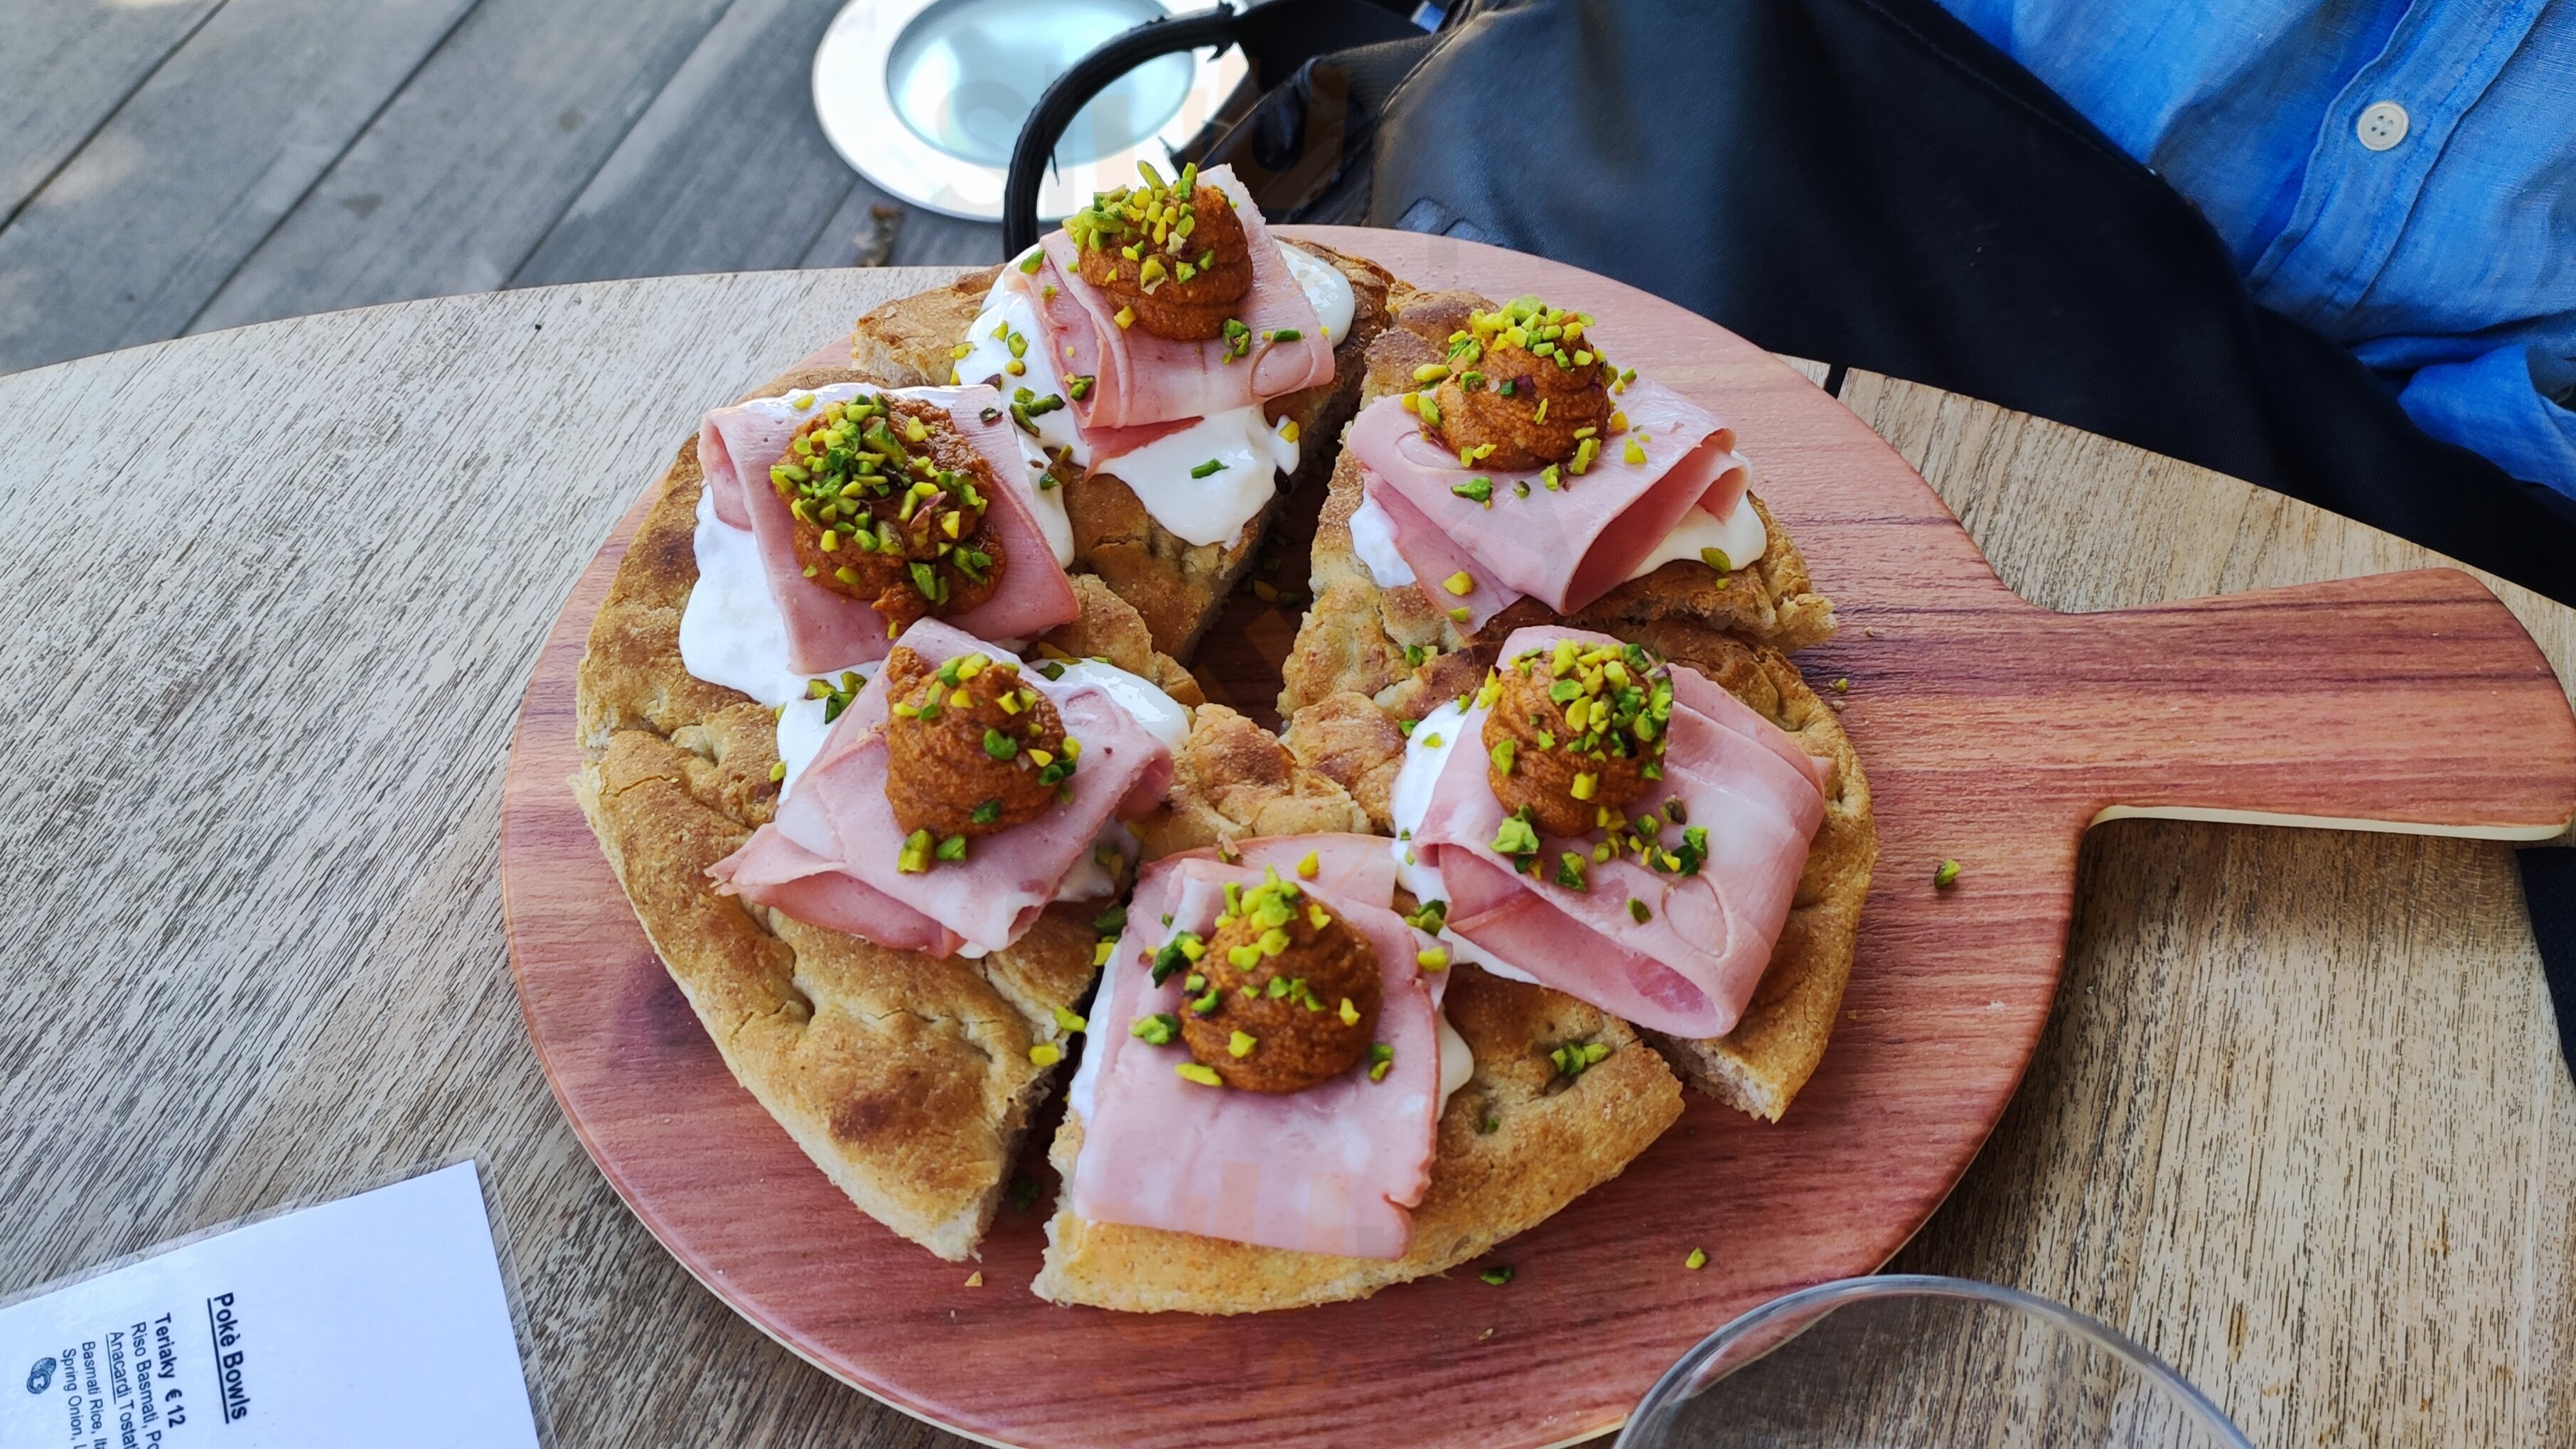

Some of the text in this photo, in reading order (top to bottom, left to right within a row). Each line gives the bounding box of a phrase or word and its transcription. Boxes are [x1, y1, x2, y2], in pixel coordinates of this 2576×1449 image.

[109, 1332, 132, 1399] Anacardi
[131, 1321, 148, 1357] Riso
[213, 1292, 250, 1420] Pokè Bowls
[60, 1348, 79, 1391] Spring
[82, 1341, 102, 1395] Basmati
[136, 1359, 159, 1428] Basmati,
[154, 1311, 186, 1428] Teriaky € 12
[68, 1395, 84, 1440] Onion,
[89, 1399, 104, 1434] Rice,
